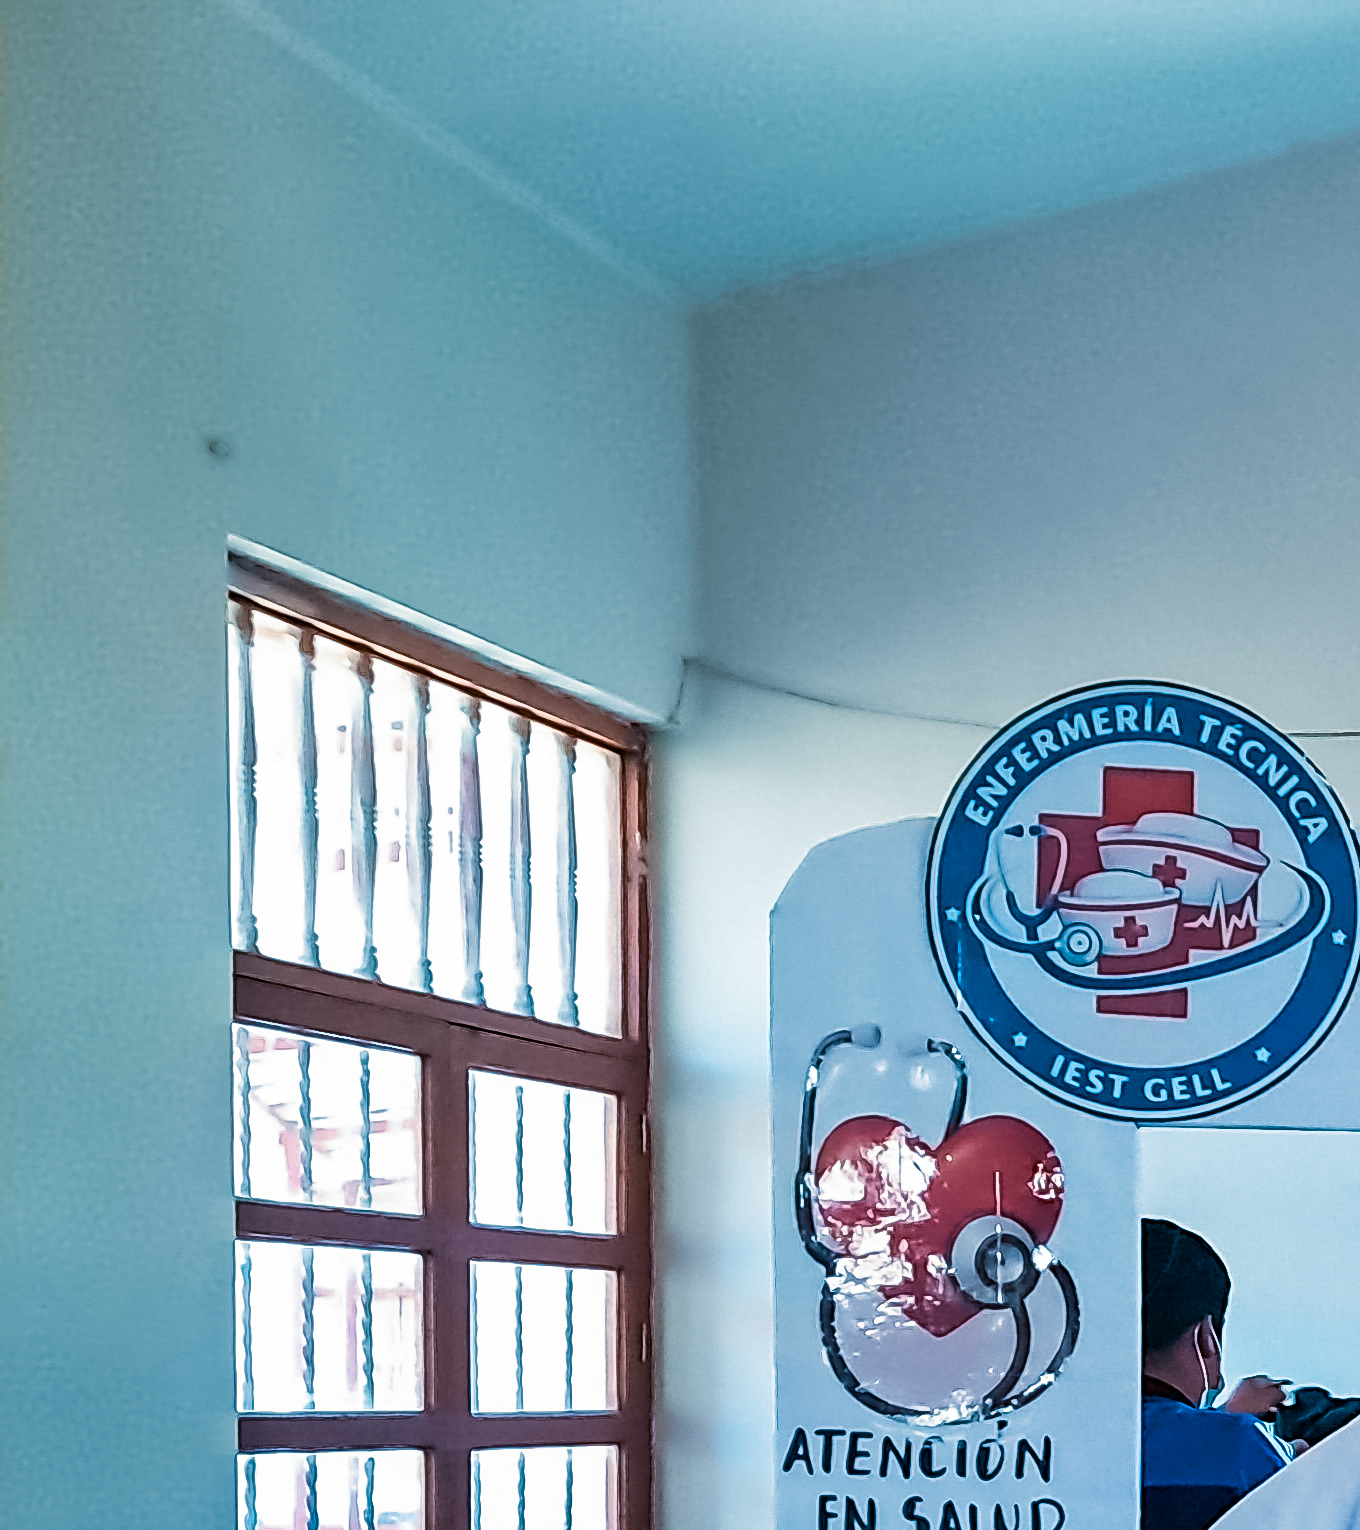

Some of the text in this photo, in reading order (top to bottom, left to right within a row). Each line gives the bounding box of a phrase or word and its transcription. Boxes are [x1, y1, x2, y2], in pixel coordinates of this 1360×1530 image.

[964, 698, 1329, 844] ENFERMERÍA TÉCNICA
[1050, 1054, 1232, 1102] IEST GELL
[782, 1420, 1051, 1483] ATENCIÓN
